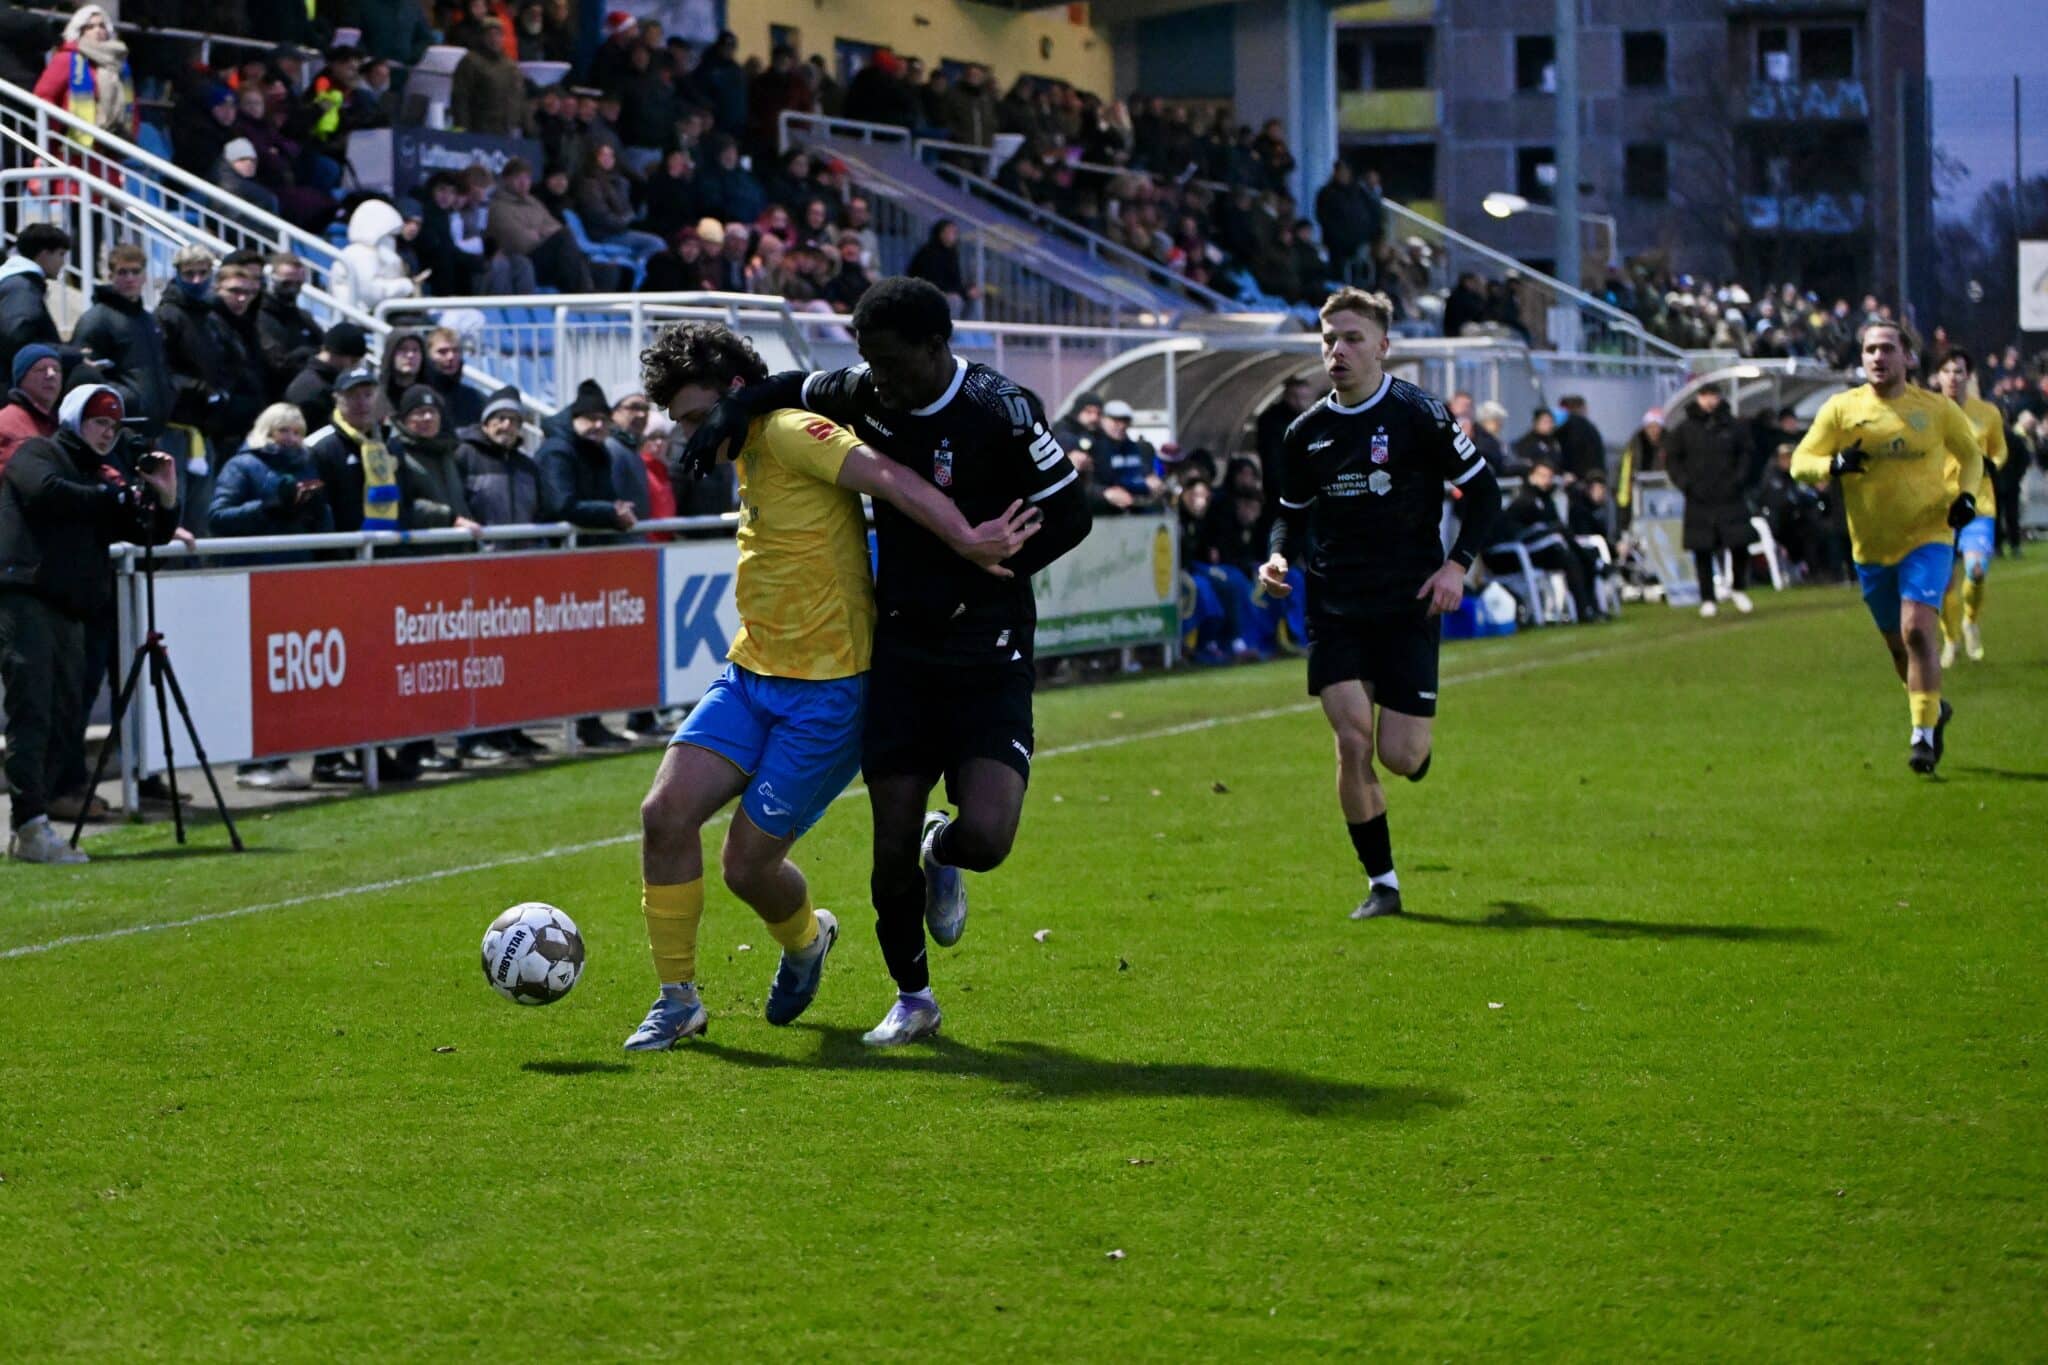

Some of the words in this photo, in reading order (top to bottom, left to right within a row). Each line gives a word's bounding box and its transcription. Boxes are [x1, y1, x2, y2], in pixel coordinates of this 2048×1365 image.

[394, 596, 531, 646] Bezirksdirektion
[534, 590, 605, 633] Burkhard
[608, 587, 646, 627] Höse
[267, 626, 346, 693] ERGO
[395, 662, 416, 696] Tel
[418, 659, 460, 693] 03371
[497, 929, 527, 983] DERBYSTAR
